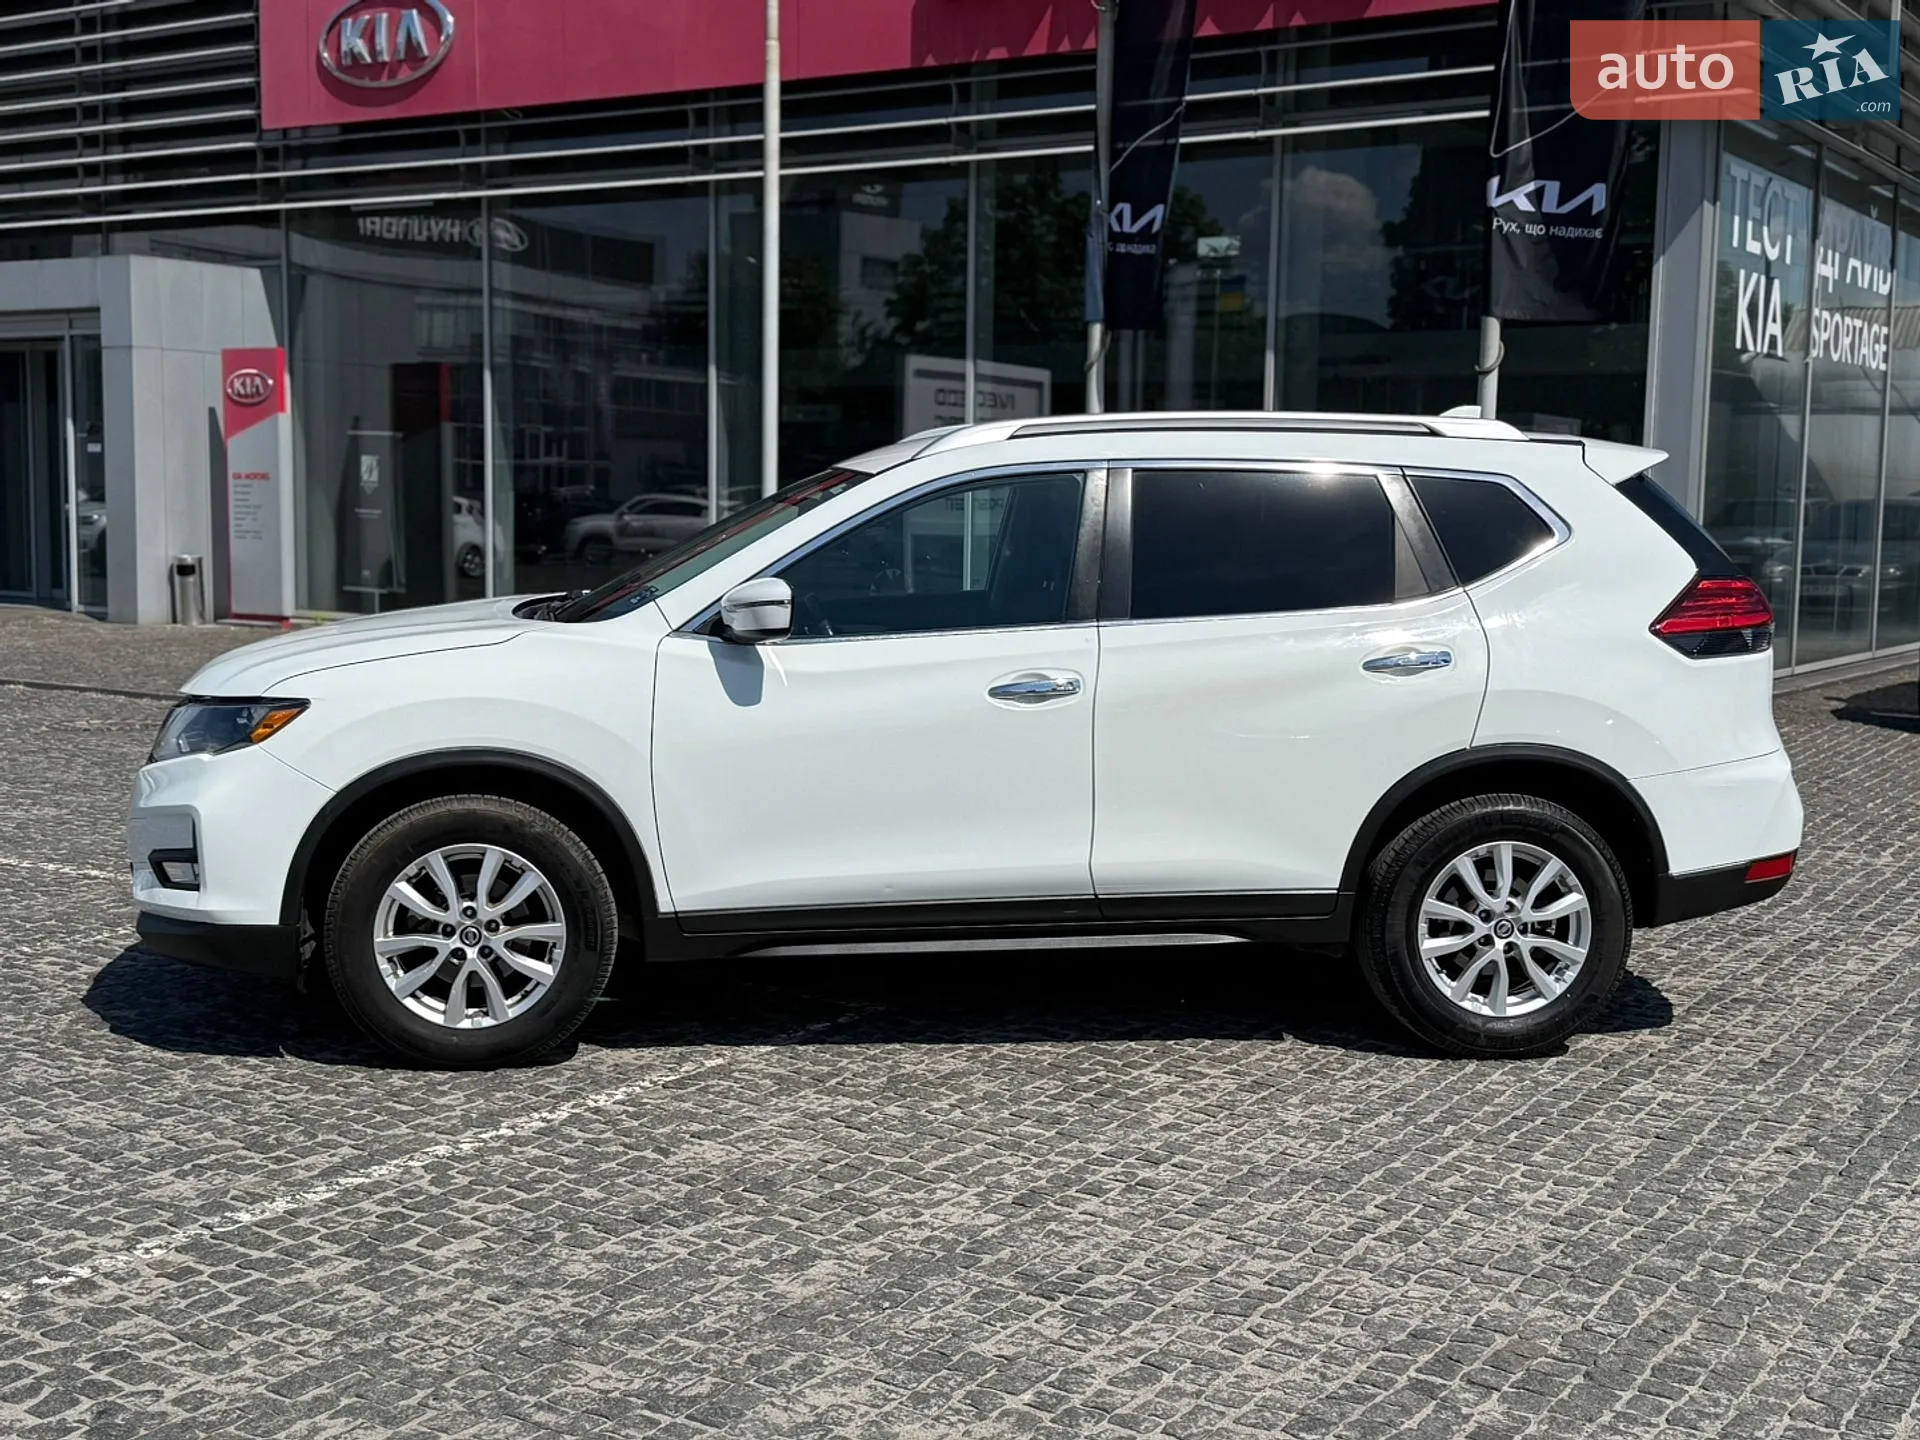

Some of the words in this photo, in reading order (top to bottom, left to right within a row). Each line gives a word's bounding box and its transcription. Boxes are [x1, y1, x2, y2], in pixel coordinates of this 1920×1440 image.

[341, 9, 429, 66] KIA
[1486, 174, 1606, 217] KIA
[1492, 217, 1520, 234] Рух,
[1525, 223, 1546, 236] що
[1549, 225, 1604, 239] надихає
[1735, 268, 1783, 357] KIA
[1811, 307, 1888, 371] SPORTAGE
[233, 376, 264, 395] KIA
